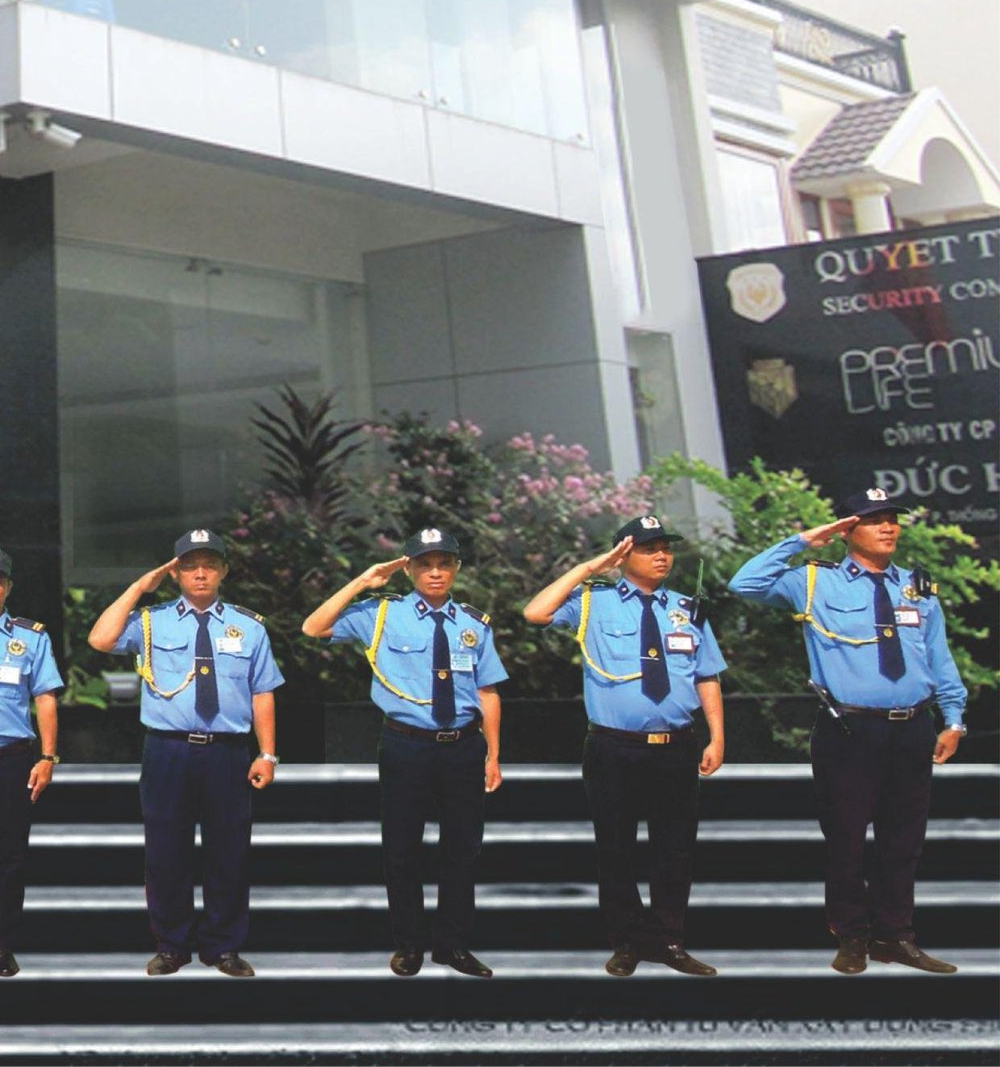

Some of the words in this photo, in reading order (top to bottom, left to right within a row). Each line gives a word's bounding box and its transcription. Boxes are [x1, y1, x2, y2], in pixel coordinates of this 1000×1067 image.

[815, 235, 960, 283] QUYET
[823, 285, 944, 316] SECURITY
[937, 421, 963, 442] TY
[969, 419, 996, 440] CP
[873, 457, 972, 497] ĐỨC
